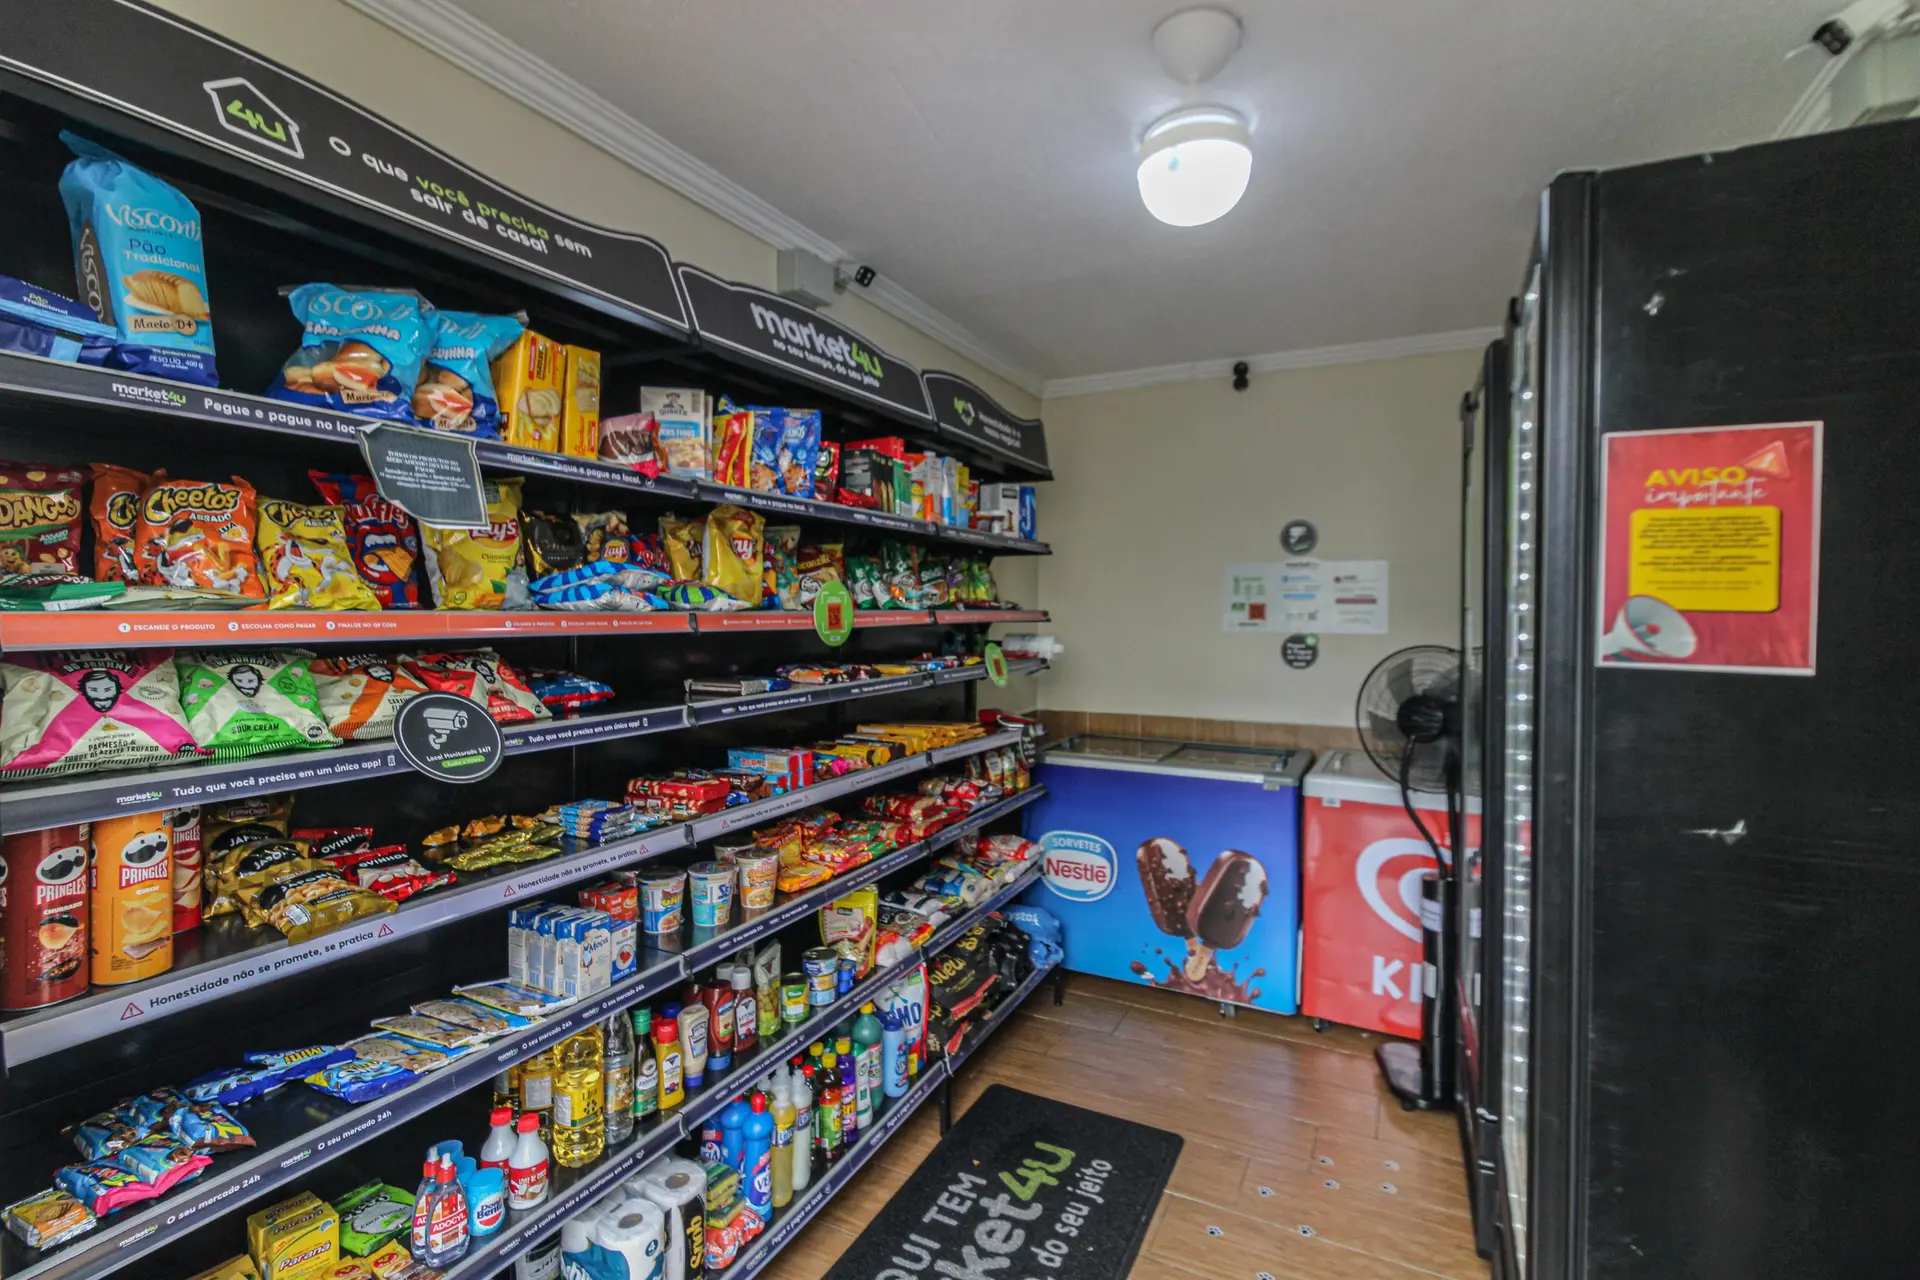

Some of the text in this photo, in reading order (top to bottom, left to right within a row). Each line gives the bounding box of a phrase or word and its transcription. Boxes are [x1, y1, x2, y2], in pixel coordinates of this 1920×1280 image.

[226, 99, 287, 142] 4U
[328, 136, 592, 258] O que você precisa sem
[409, 187, 455, 215] sair
[462, 208, 489, 231] de
[123, 249, 200, 274] Tradicional
[129, 238, 167, 254] Pão
[750, 302, 883, 378] market4u
[112, 383, 187, 404] market4u
[204, 397, 250, 418] Pegue
[254, 409, 264, 419] e
[269, 411, 311, 429] pague
[316, 418, 333, 431] no
[586, 467, 610, 479] pague
[611, 472, 621, 481] no
[1645, 465, 1748, 488] AVISO
[143, 483, 242, 526] Cheetos
[1644, 476, 1769, 510] importante
[133, 623, 170, 631] ESCANEIE
[180, 623, 216, 631] PRODUTO
[241, 622, 273, 630] ESCOLHA
[83, 660, 132, 673] JOHNNY
[231, 723, 279, 735] SOUR CREAM
[528, 735, 545, 744] Tudo
[545, 733, 557, 743] que
[558, 729, 572, 739] você
[572, 727, 594, 738] precisa
[614, 722, 628, 730] único
[126, 745, 159, 754] TRUFADO
[426, 753, 444, 762] Local
[444, 747, 478, 760] Monitorado
[116, 758, 382, 804] market4u Tudo que você precisa em um único app!
[1052, 837, 1102, 853] SORVETES
[120, 859, 168, 888] PRINGLES
[517, 871, 560, 892] Honestidade
[561, 868, 574, 879] não
[574, 866, 582, 874] se
[582, 857, 609, 872] promete,
[618, 848, 638, 862] pratica
[36, 874, 87, 907] PRINGLES
[150, 930, 374, 1008] Honestidade não se promete, se pratica
[1371, 954, 1422, 1001] KI
[528, 1038, 539, 1047] seu
[539, 1026, 561, 1042] mercado
[562, 1020, 573, 1030] 24h
[318, 1142, 325, 1150] O
[327, 1135, 341, 1146] seu
[342, 1119, 376, 1139] mercado
[377, 1110, 392, 1122] 24h
[166, 1216, 176, 1225] O
[178, 1206, 196, 1220] seu
[198, 1184, 241, 1209] mercado
[241, 1174, 260, 1189] 24h
[523, 1227, 538, 1238] Você
[538, 1213, 556, 1228] confia
[556, 1206, 566, 1215] em
[566, 1198, 575, 1209] nós
[580, 1190, 589, 1200] nós
[589, 1172, 614, 1192] confiamos
[614, 1166, 623, 1174] em
[622, 1158, 634, 1169] você
[922, 1171, 987, 1226] TEM
[1031, 1159, 1113, 1269] do seu jeito
[432, 1213, 466, 1233] ADOCYL
[279, 1240, 332, 1272] Paraná
